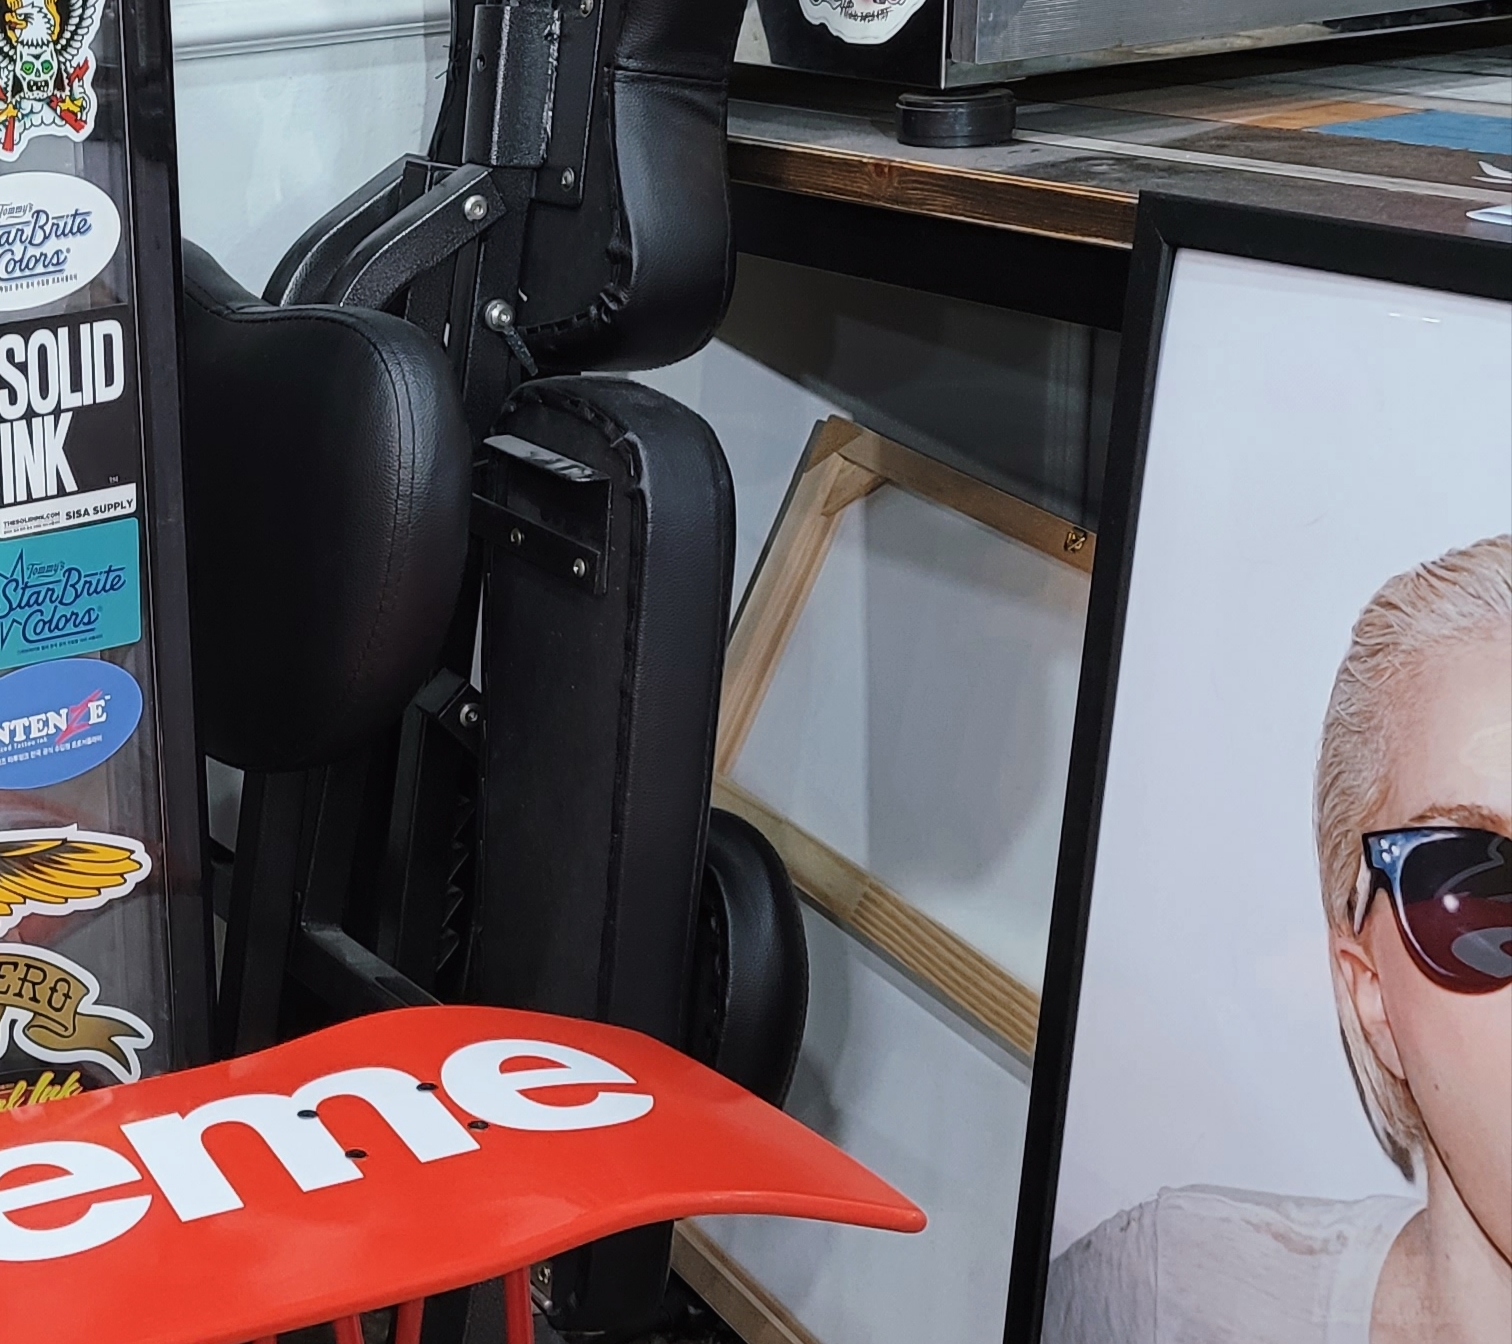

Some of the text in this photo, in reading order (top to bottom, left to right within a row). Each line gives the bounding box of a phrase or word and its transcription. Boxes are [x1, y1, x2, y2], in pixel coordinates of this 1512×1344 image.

[64, 498, 134, 521] SISA SUPPLY
[25, 559, 66, 580] Tommy's
[21, 606, 101, 645] Colors
